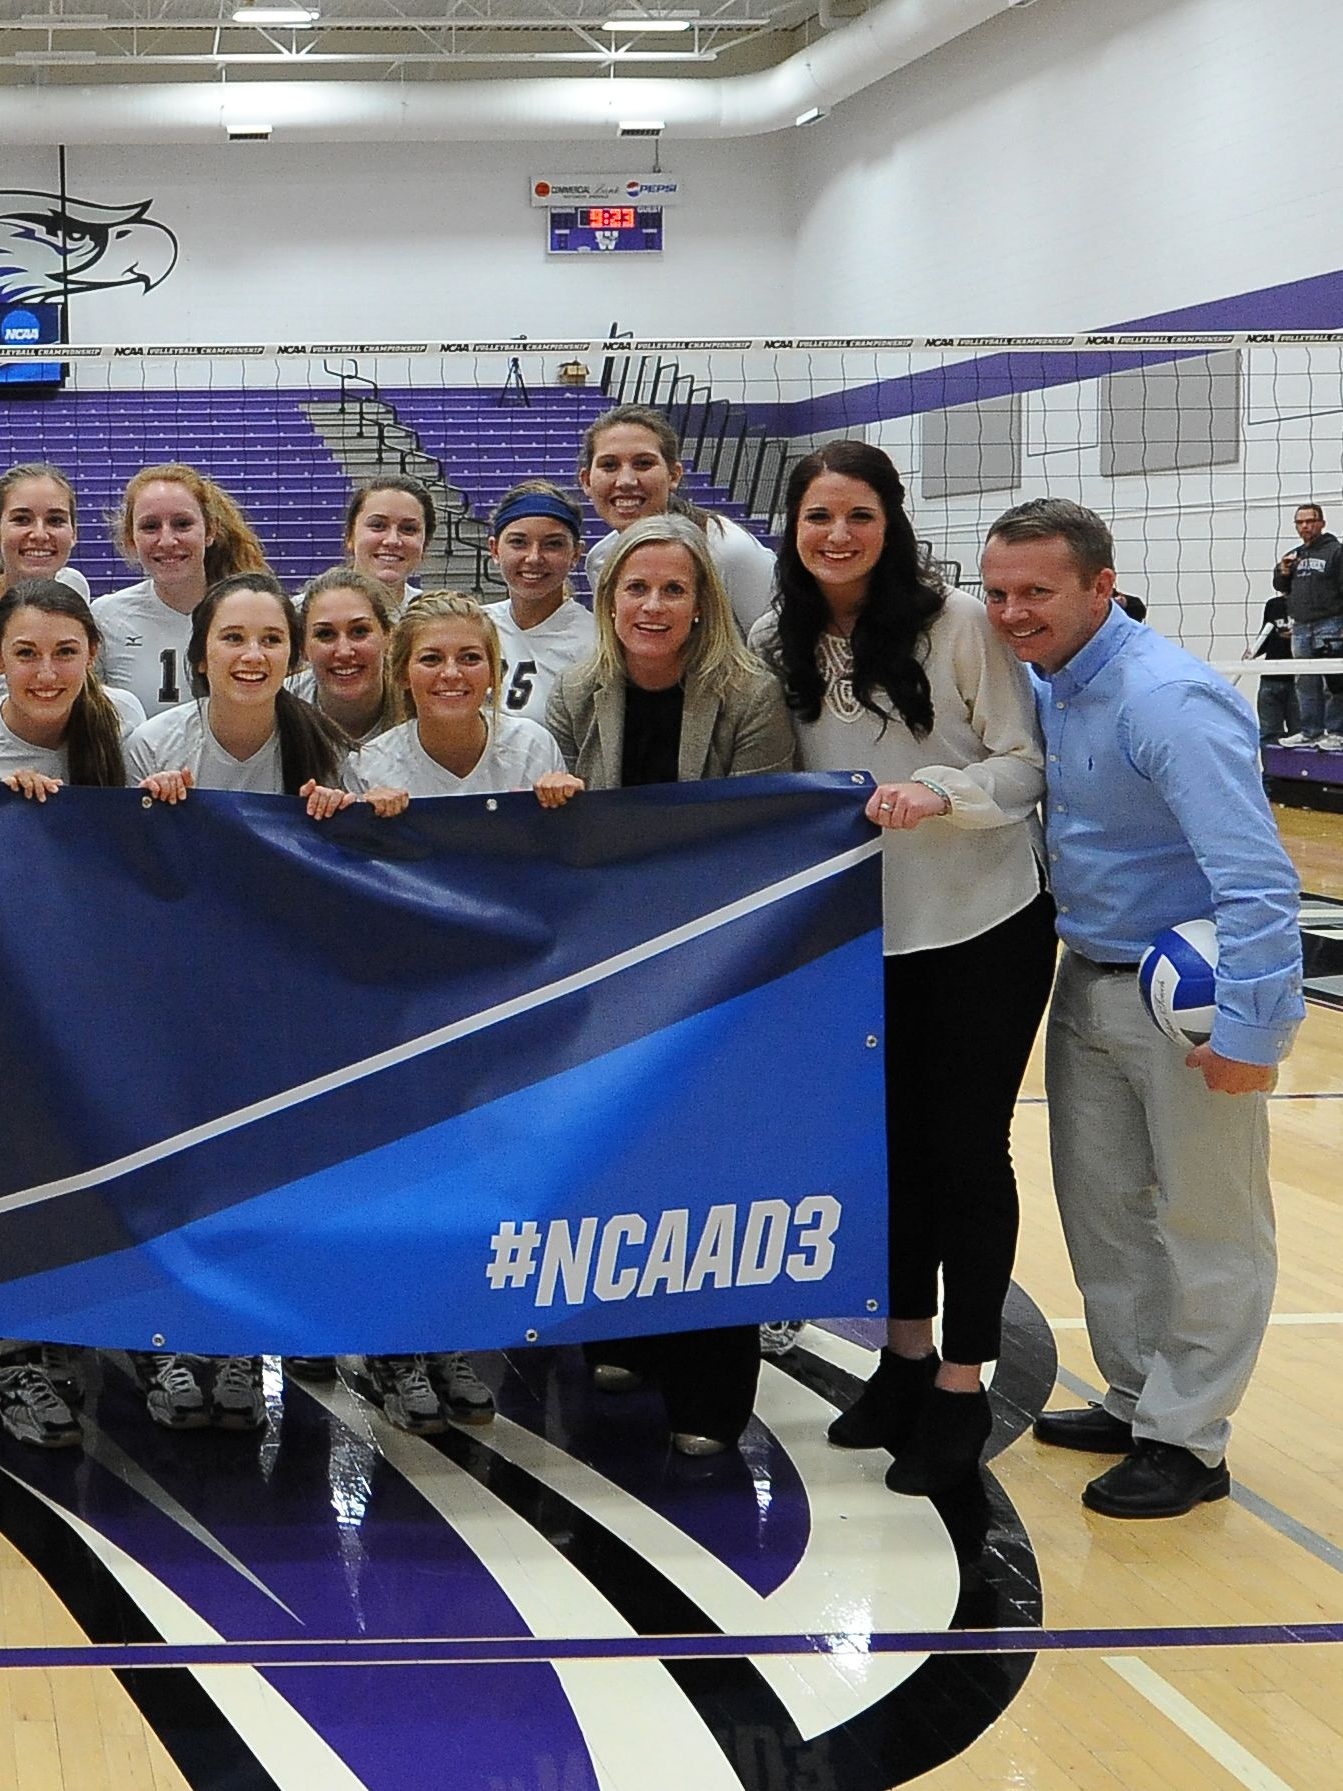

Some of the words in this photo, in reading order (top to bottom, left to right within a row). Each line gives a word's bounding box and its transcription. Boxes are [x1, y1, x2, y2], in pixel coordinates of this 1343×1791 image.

[640, 184, 677, 193] PEPSI
[4, 328, 39, 340] NCAA
[1245, 334, 1274, 343] NCAA
[1279, 334, 1329, 342] VOLLEYBALL
[763, 340, 792, 349] NCAA
[798, 339, 848, 348] VOLLEYBALL
[850, 339, 912, 348] CHAMPIONSHIP
[924, 338, 953, 347] NCAA
[958, 337, 1008, 346] VOLLEYBALL
[1010, 337, 1072, 346] CHAMPIONSHIP
[1085, 336, 1114, 345] NCAA
[1119, 335, 1169, 344] VOLLEYBALL
[1171, 335, 1233, 344] CHAMPIONSHIP
[113, 347, 143, 356] NCAA
[148, 346, 198, 355] VOLLEYBALL
[200, 346, 262, 355] CHAMPIONSHIP
[276, 345, 306, 355] NCAA
[311, 345, 361, 353] VOLLEYBALL
[363, 345, 425, 353] CHAMPIONSHIP
[439, 343, 469, 353] NCAA
[474, 343, 524, 351] VOLLEYBALL
[526, 343, 588, 351] CHAMPIONSHIP
[601, 341, 631, 351] NCAA
[636, 341, 686, 350] VOLLEYBALL
[688, 341, 750, 350] CHAMPIONSHIP
[38, 348, 100, 357] CHAMPIONSHIP
[485, 1194, 843, 1308] #NCAAD3
